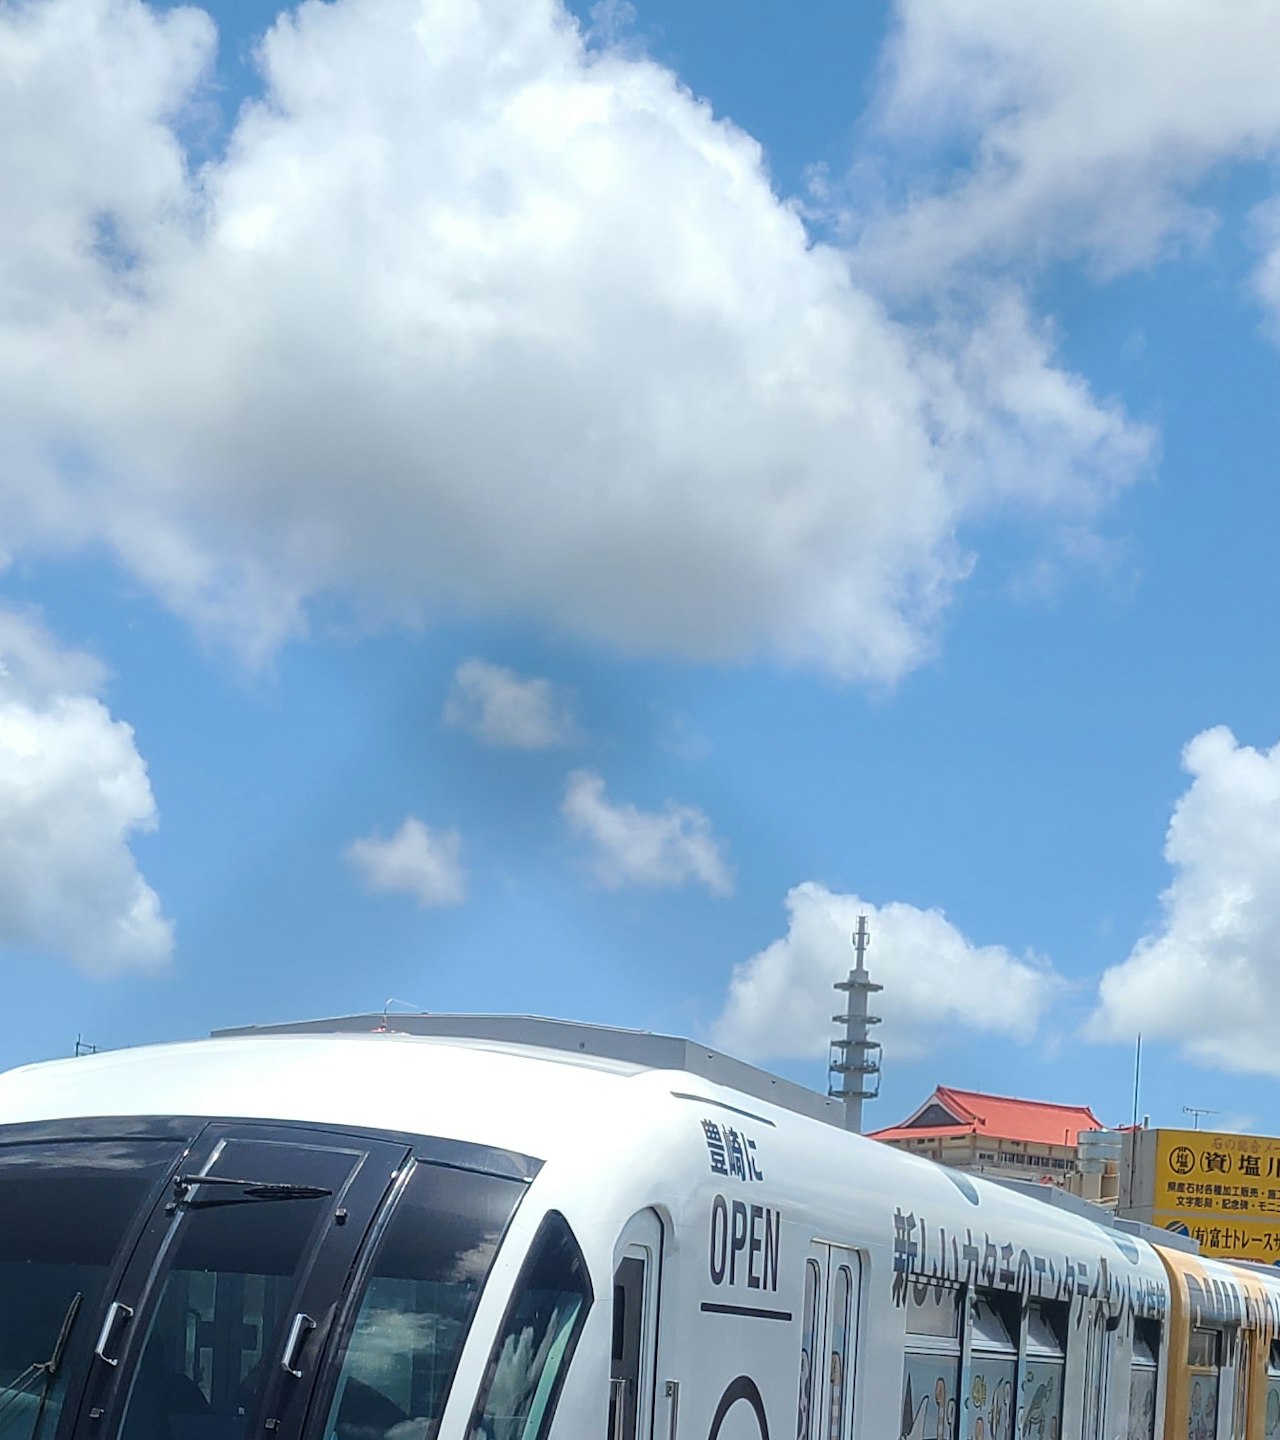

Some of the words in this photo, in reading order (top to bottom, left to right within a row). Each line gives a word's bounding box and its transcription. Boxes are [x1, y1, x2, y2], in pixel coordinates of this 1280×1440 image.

[699, 1118, 764, 1182] 豊崎に
[709, 1193, 781, 1292] OPEN
